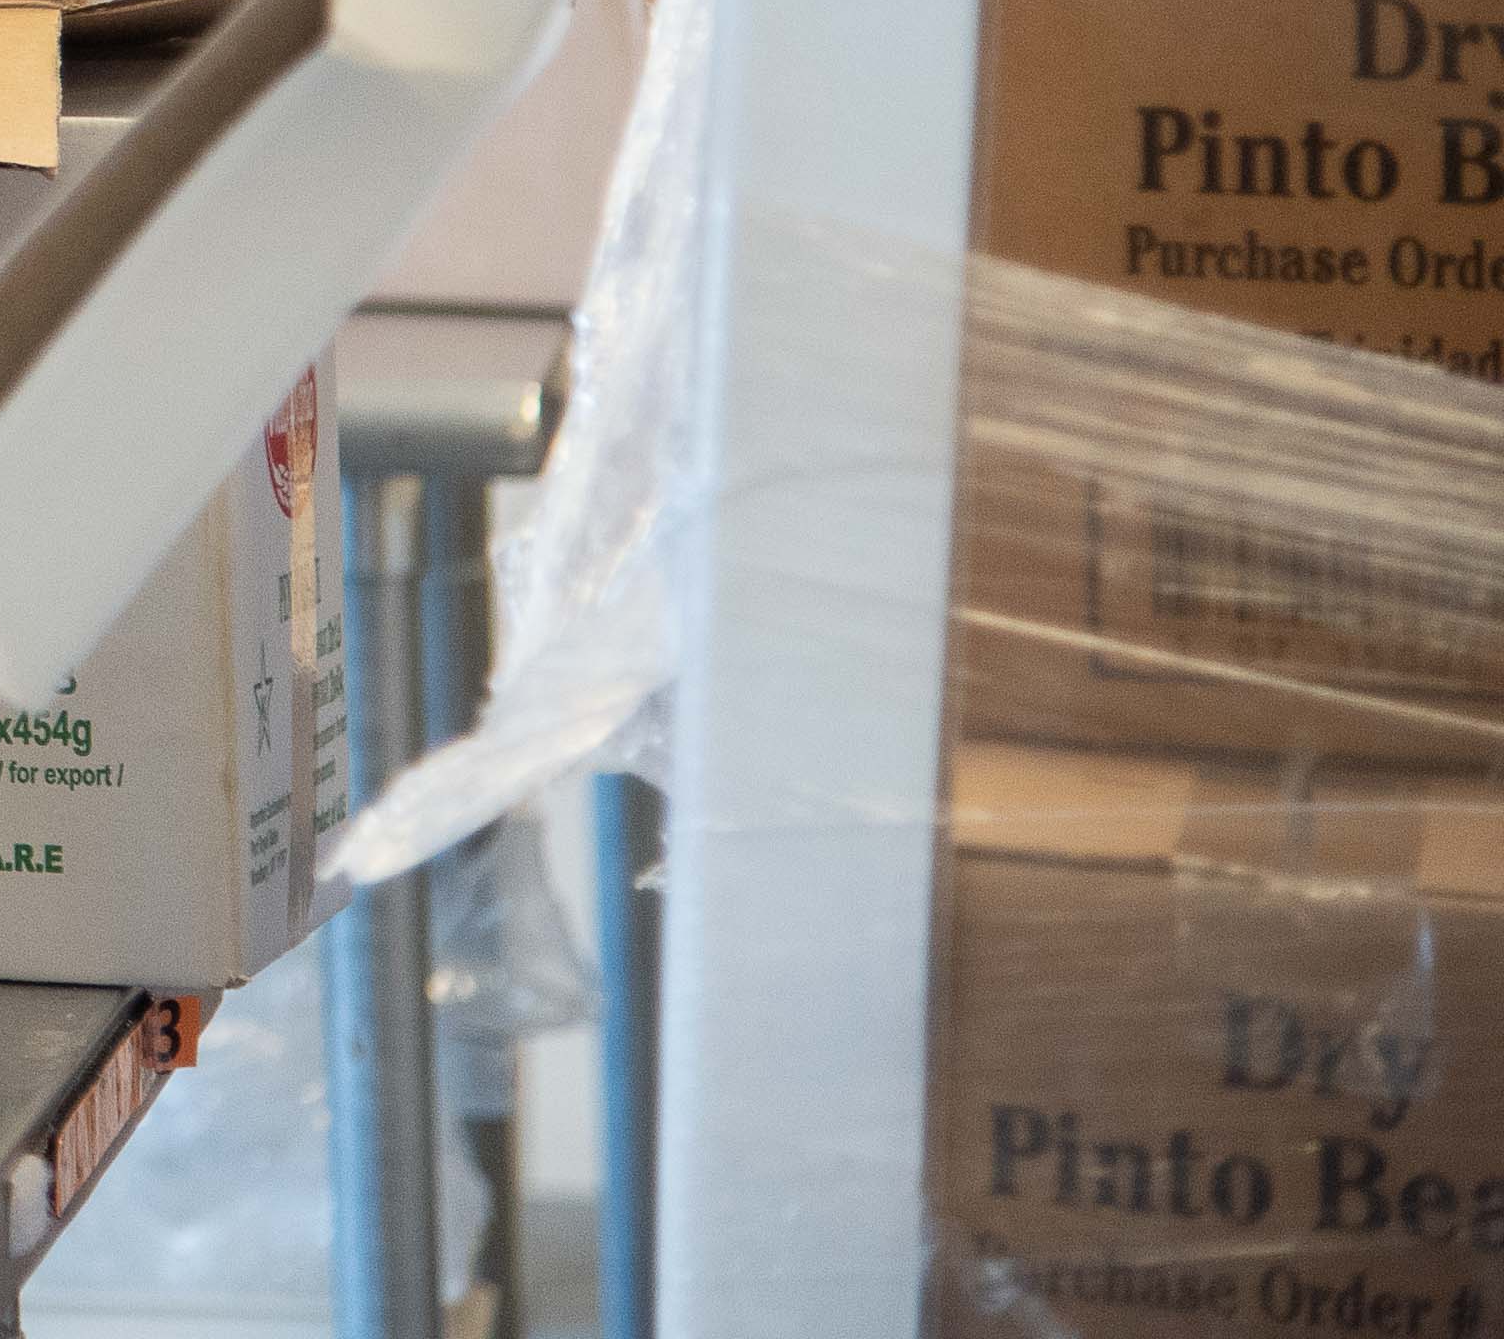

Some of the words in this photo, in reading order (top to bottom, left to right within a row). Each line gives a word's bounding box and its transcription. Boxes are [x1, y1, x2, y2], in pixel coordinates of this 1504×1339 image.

[1126, 224, 1369, 285] Purchase
[8, 760, 38, 783] for
[44, 764, 112, 790] export
[116, 762, 125, 787] /
[158, 998, 182, 1063] 3
[987, 1102, 1277, 1228] Pinto
